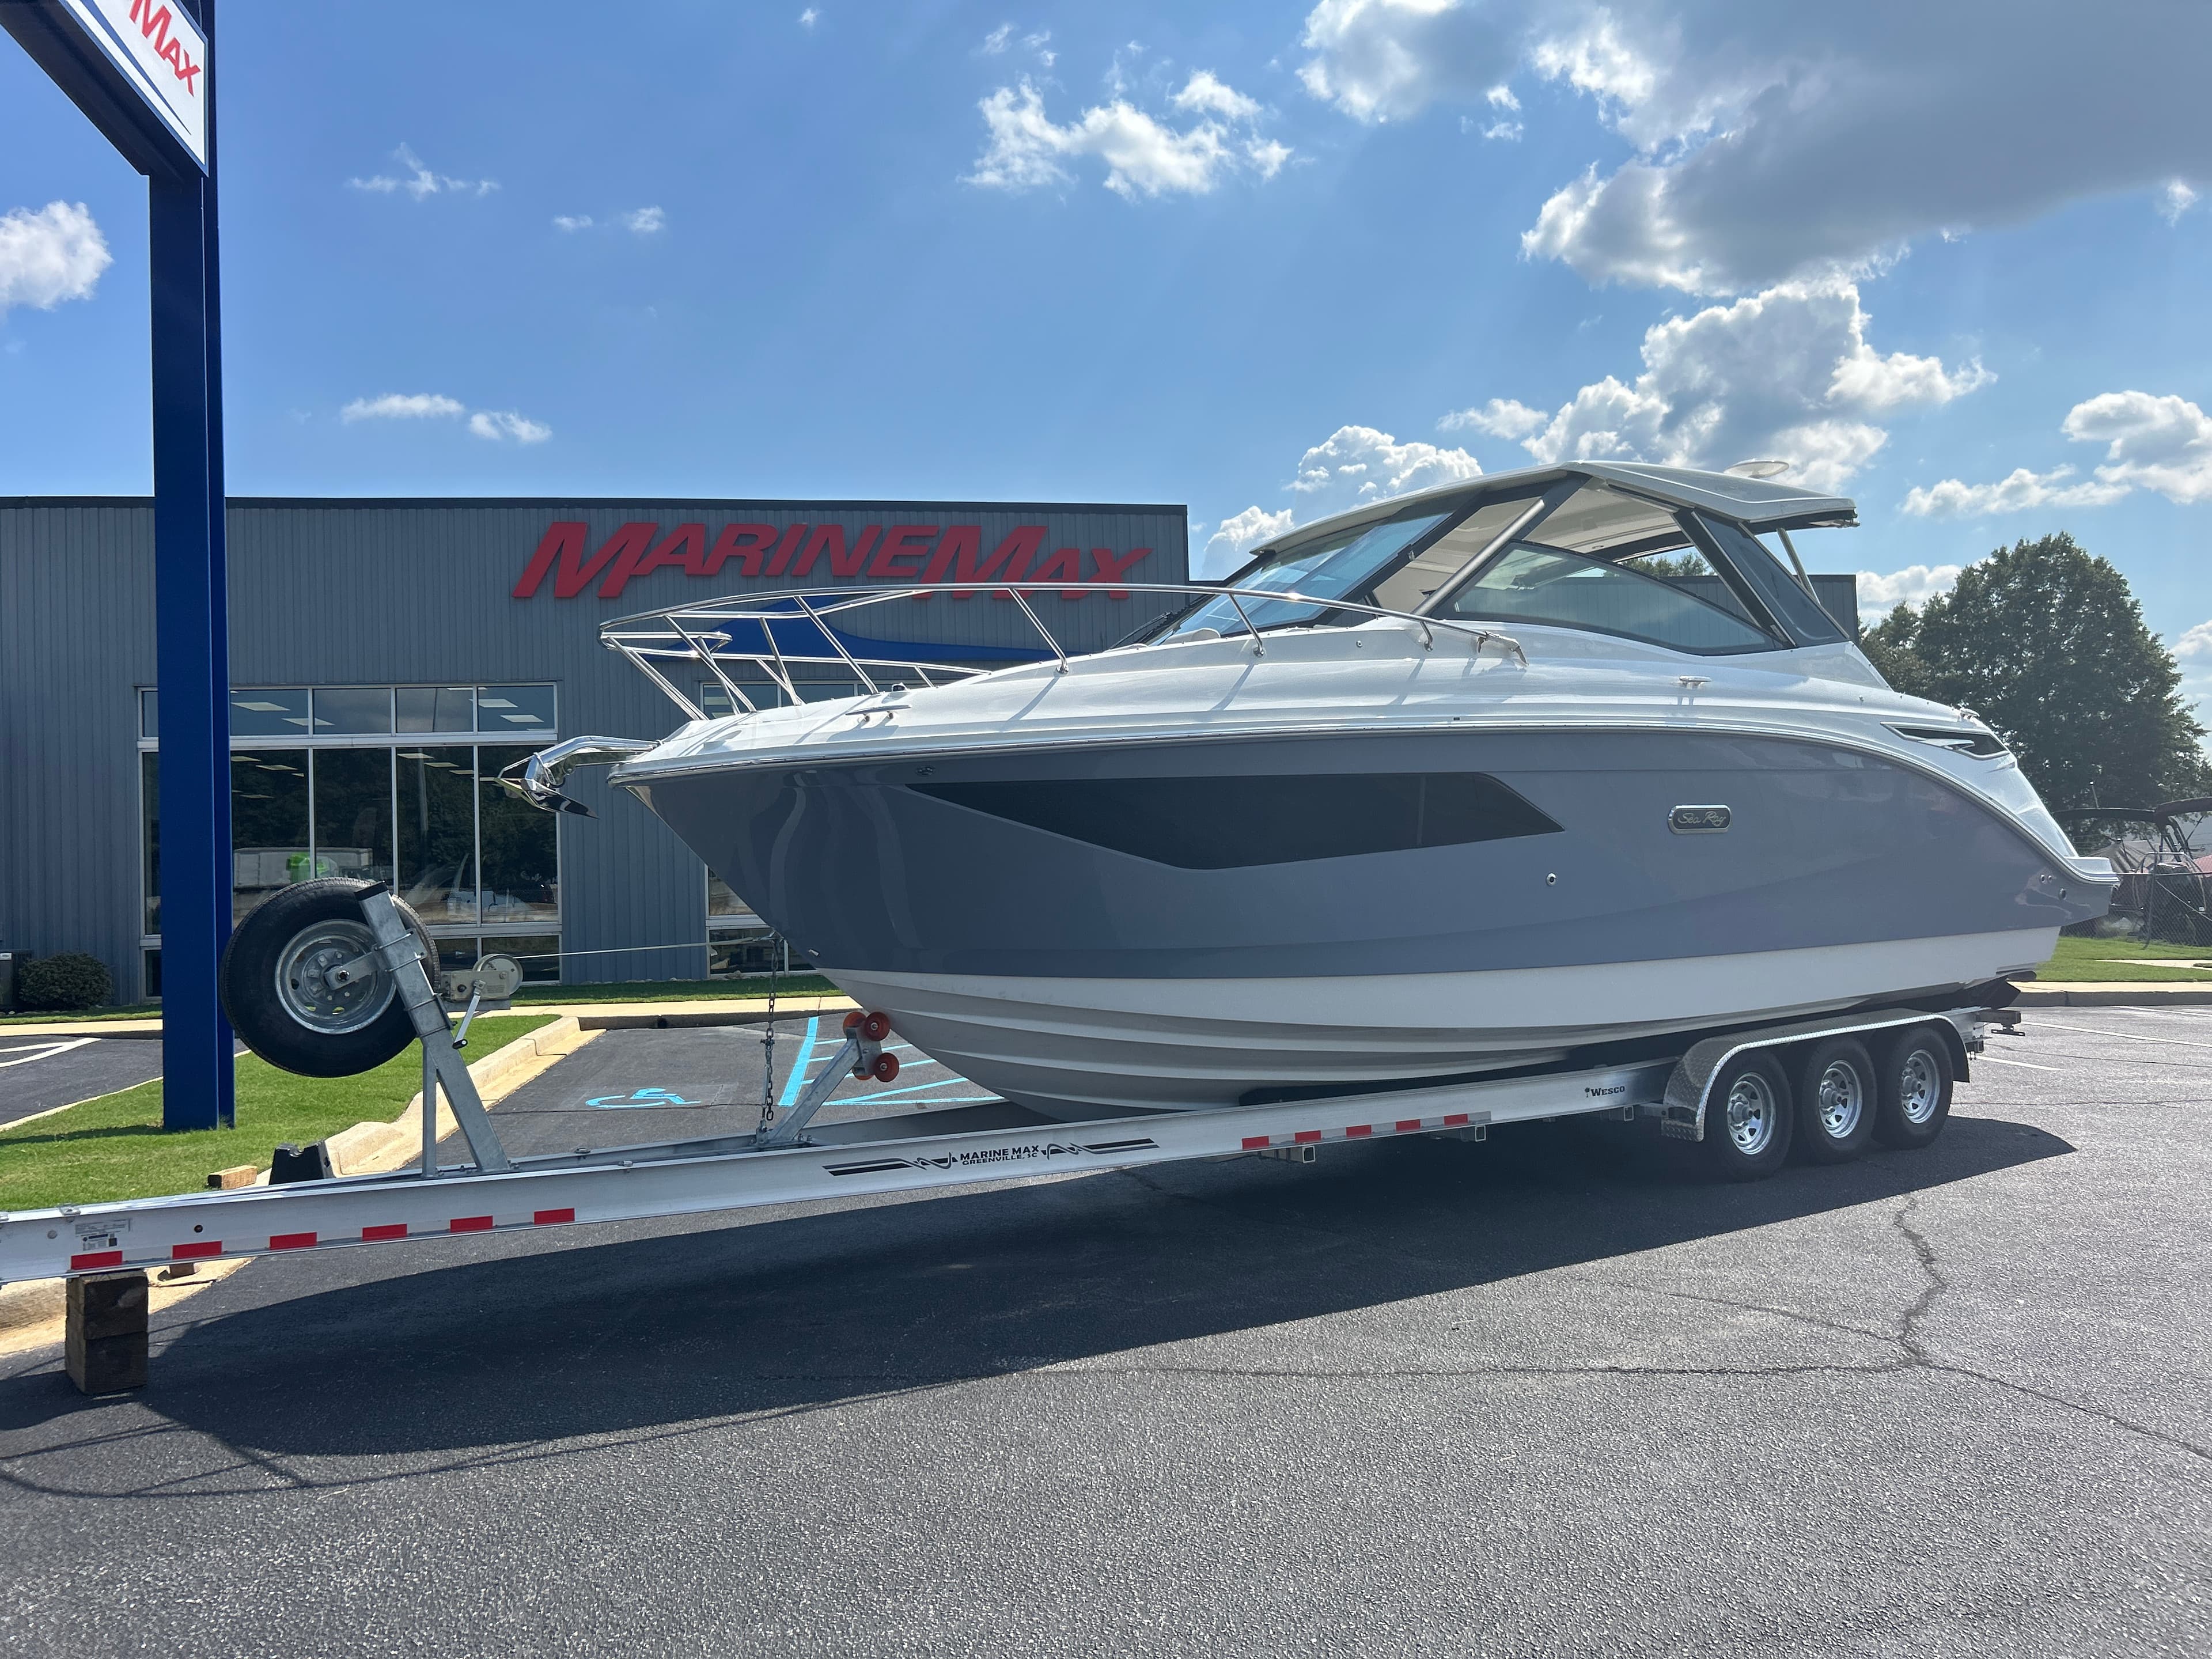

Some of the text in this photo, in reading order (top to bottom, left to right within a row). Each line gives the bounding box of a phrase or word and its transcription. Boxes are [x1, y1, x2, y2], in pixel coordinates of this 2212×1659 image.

[1677, 810, 1726, 826] Sea Ray
[960, 1145, 1039, 1161] MARINE MAX
[962, 1154, 1025, 1165] GREENVILLE,
